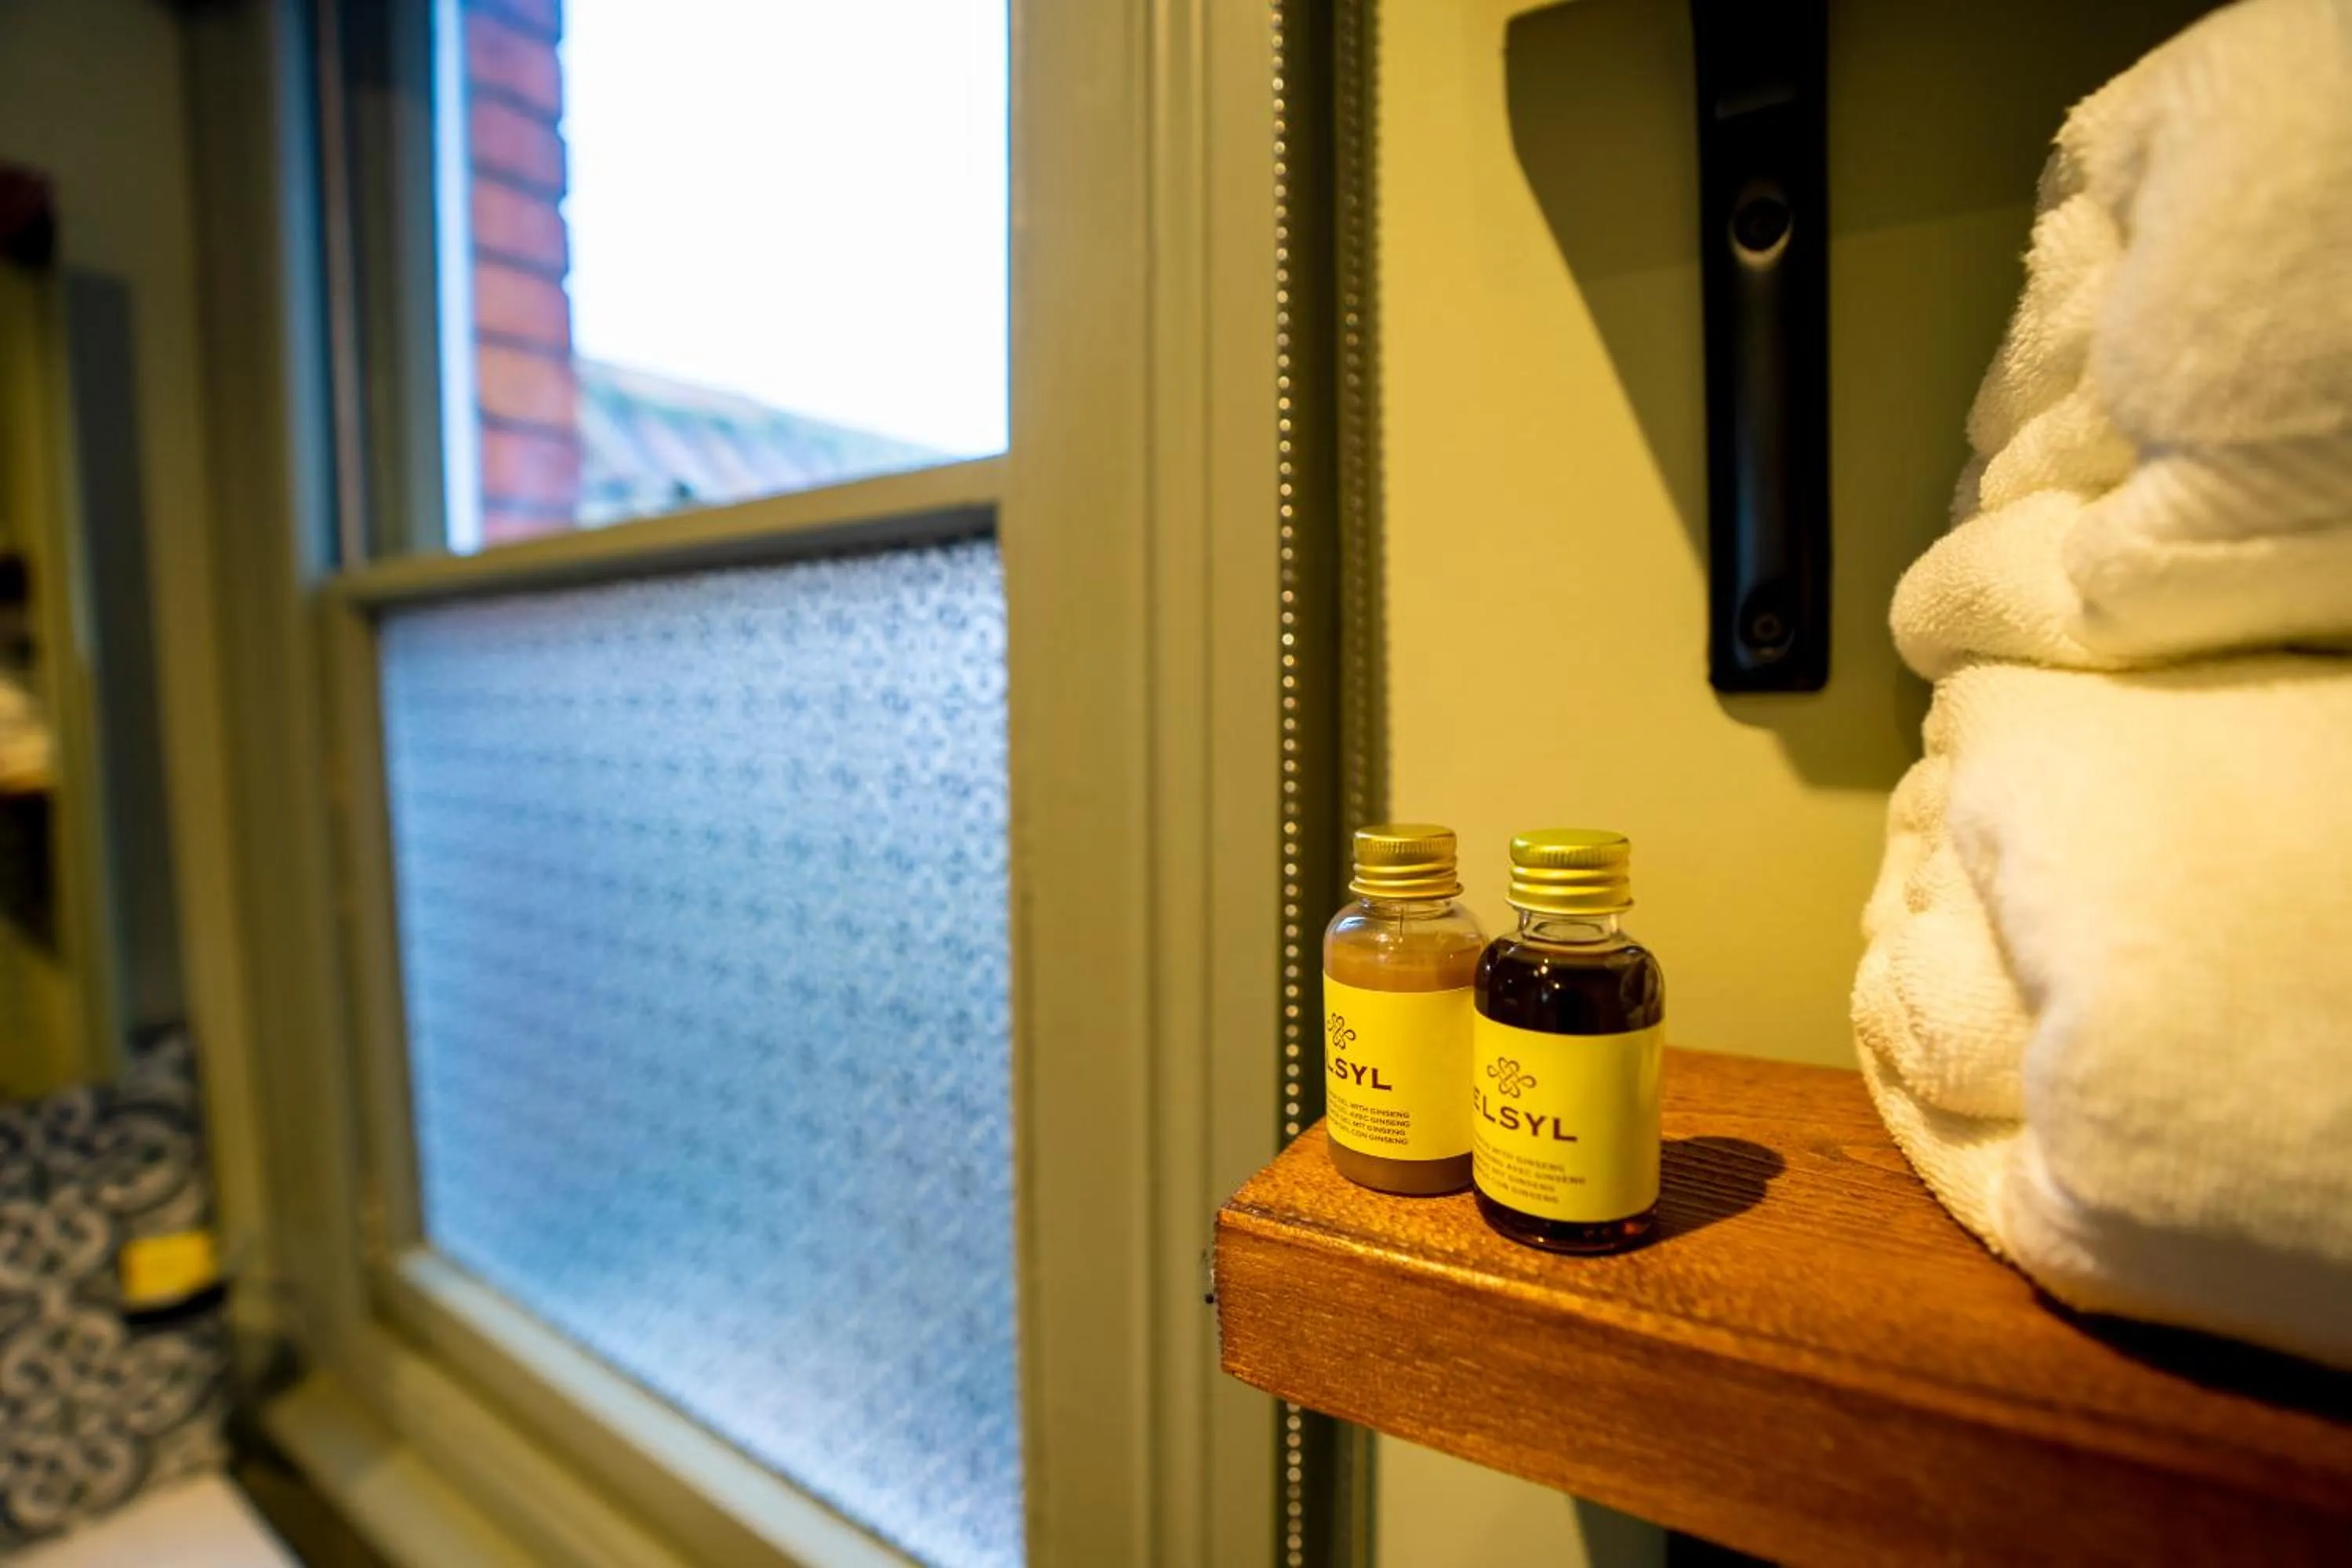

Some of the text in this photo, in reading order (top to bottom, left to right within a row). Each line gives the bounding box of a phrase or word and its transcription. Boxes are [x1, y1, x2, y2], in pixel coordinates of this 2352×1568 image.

[1369, 1108, 1410, 1120] GINSENG
[1370, 1116, 1411, 1128] GINSENG
[1367, 1125, 1406, 1136] GINSENG
[1368, 1134, 1409, 1145] GINSENG
